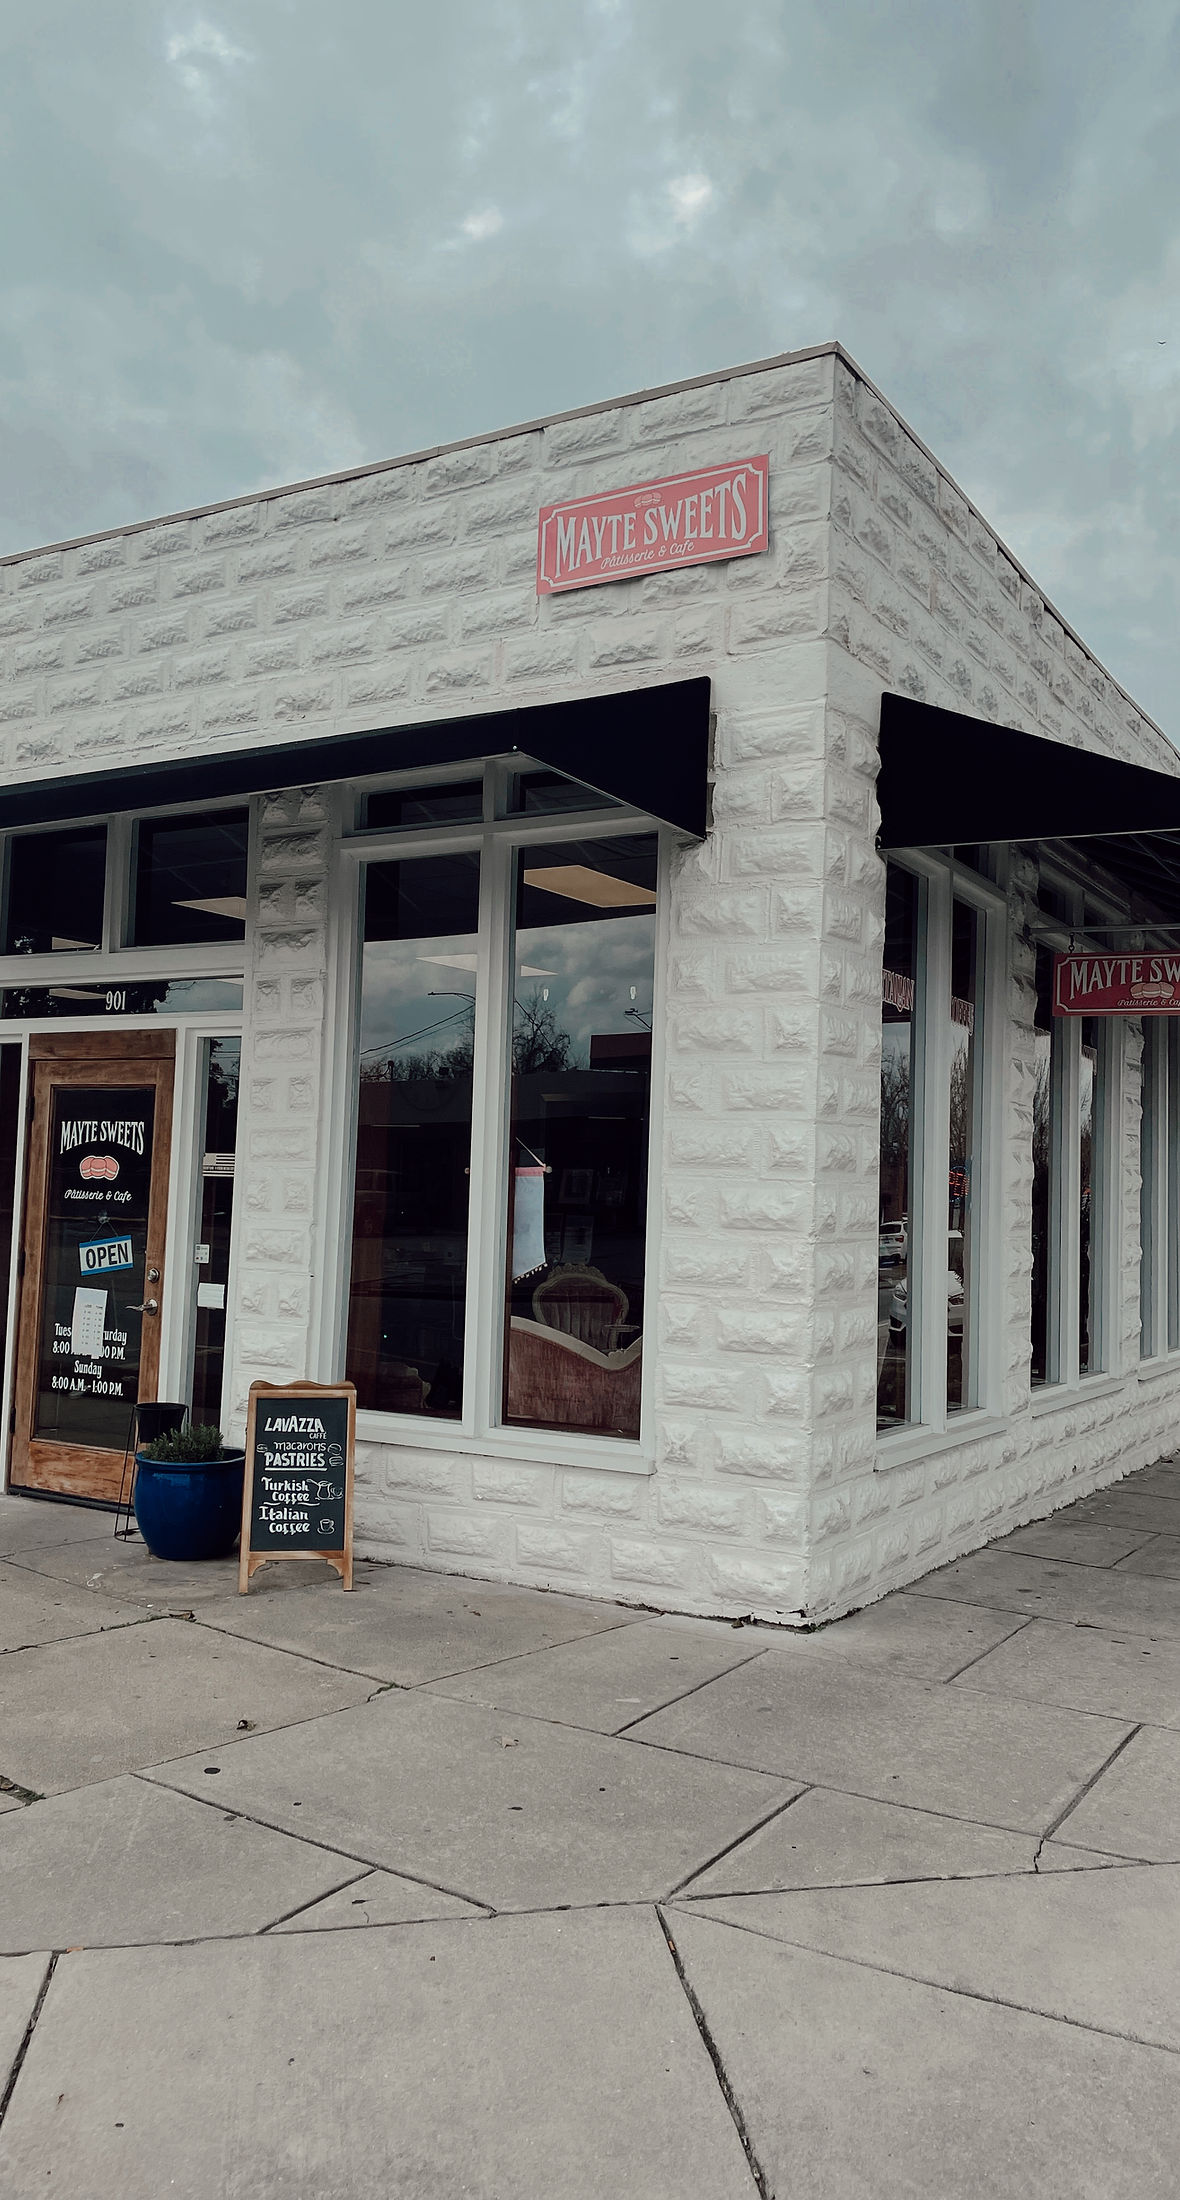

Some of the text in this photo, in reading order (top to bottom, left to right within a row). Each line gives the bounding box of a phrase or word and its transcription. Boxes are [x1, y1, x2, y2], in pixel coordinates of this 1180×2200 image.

[556, 472, 747, 578] MAYTE SWEETS
[659, 545, 667, 557] &
[1070, 959, 1144, 1000] MAYTE
[105, 991, 126, 1010] 901
[60, 1121, 144, 1155] MAYTE SWEETS
[105, 1191, 112, 1201] &
[85, 1242, 129, 1269] OPEN
[54, 1323, 127, 1345] Tues urday
[52, 1341, 70, 1354] 8:00
[111, 1346, 126, 1360] P.M.
[74, 1360, 102, 1379] Sunday
[51, 1376, 68, 1389] 8:00
[92, 1379, 108, 1394] 1:00
[109, 1381, 124, 1396] P.M.
[264, 1415, 324, 1432] LAVAZZA
[273, 1441, 327, 1451] macarons
[264, 1451, 326, 1467] PASTRIES
[261, 1476, 309, 1491] Turkish
[258, 1506, 308, 1520] Italian
